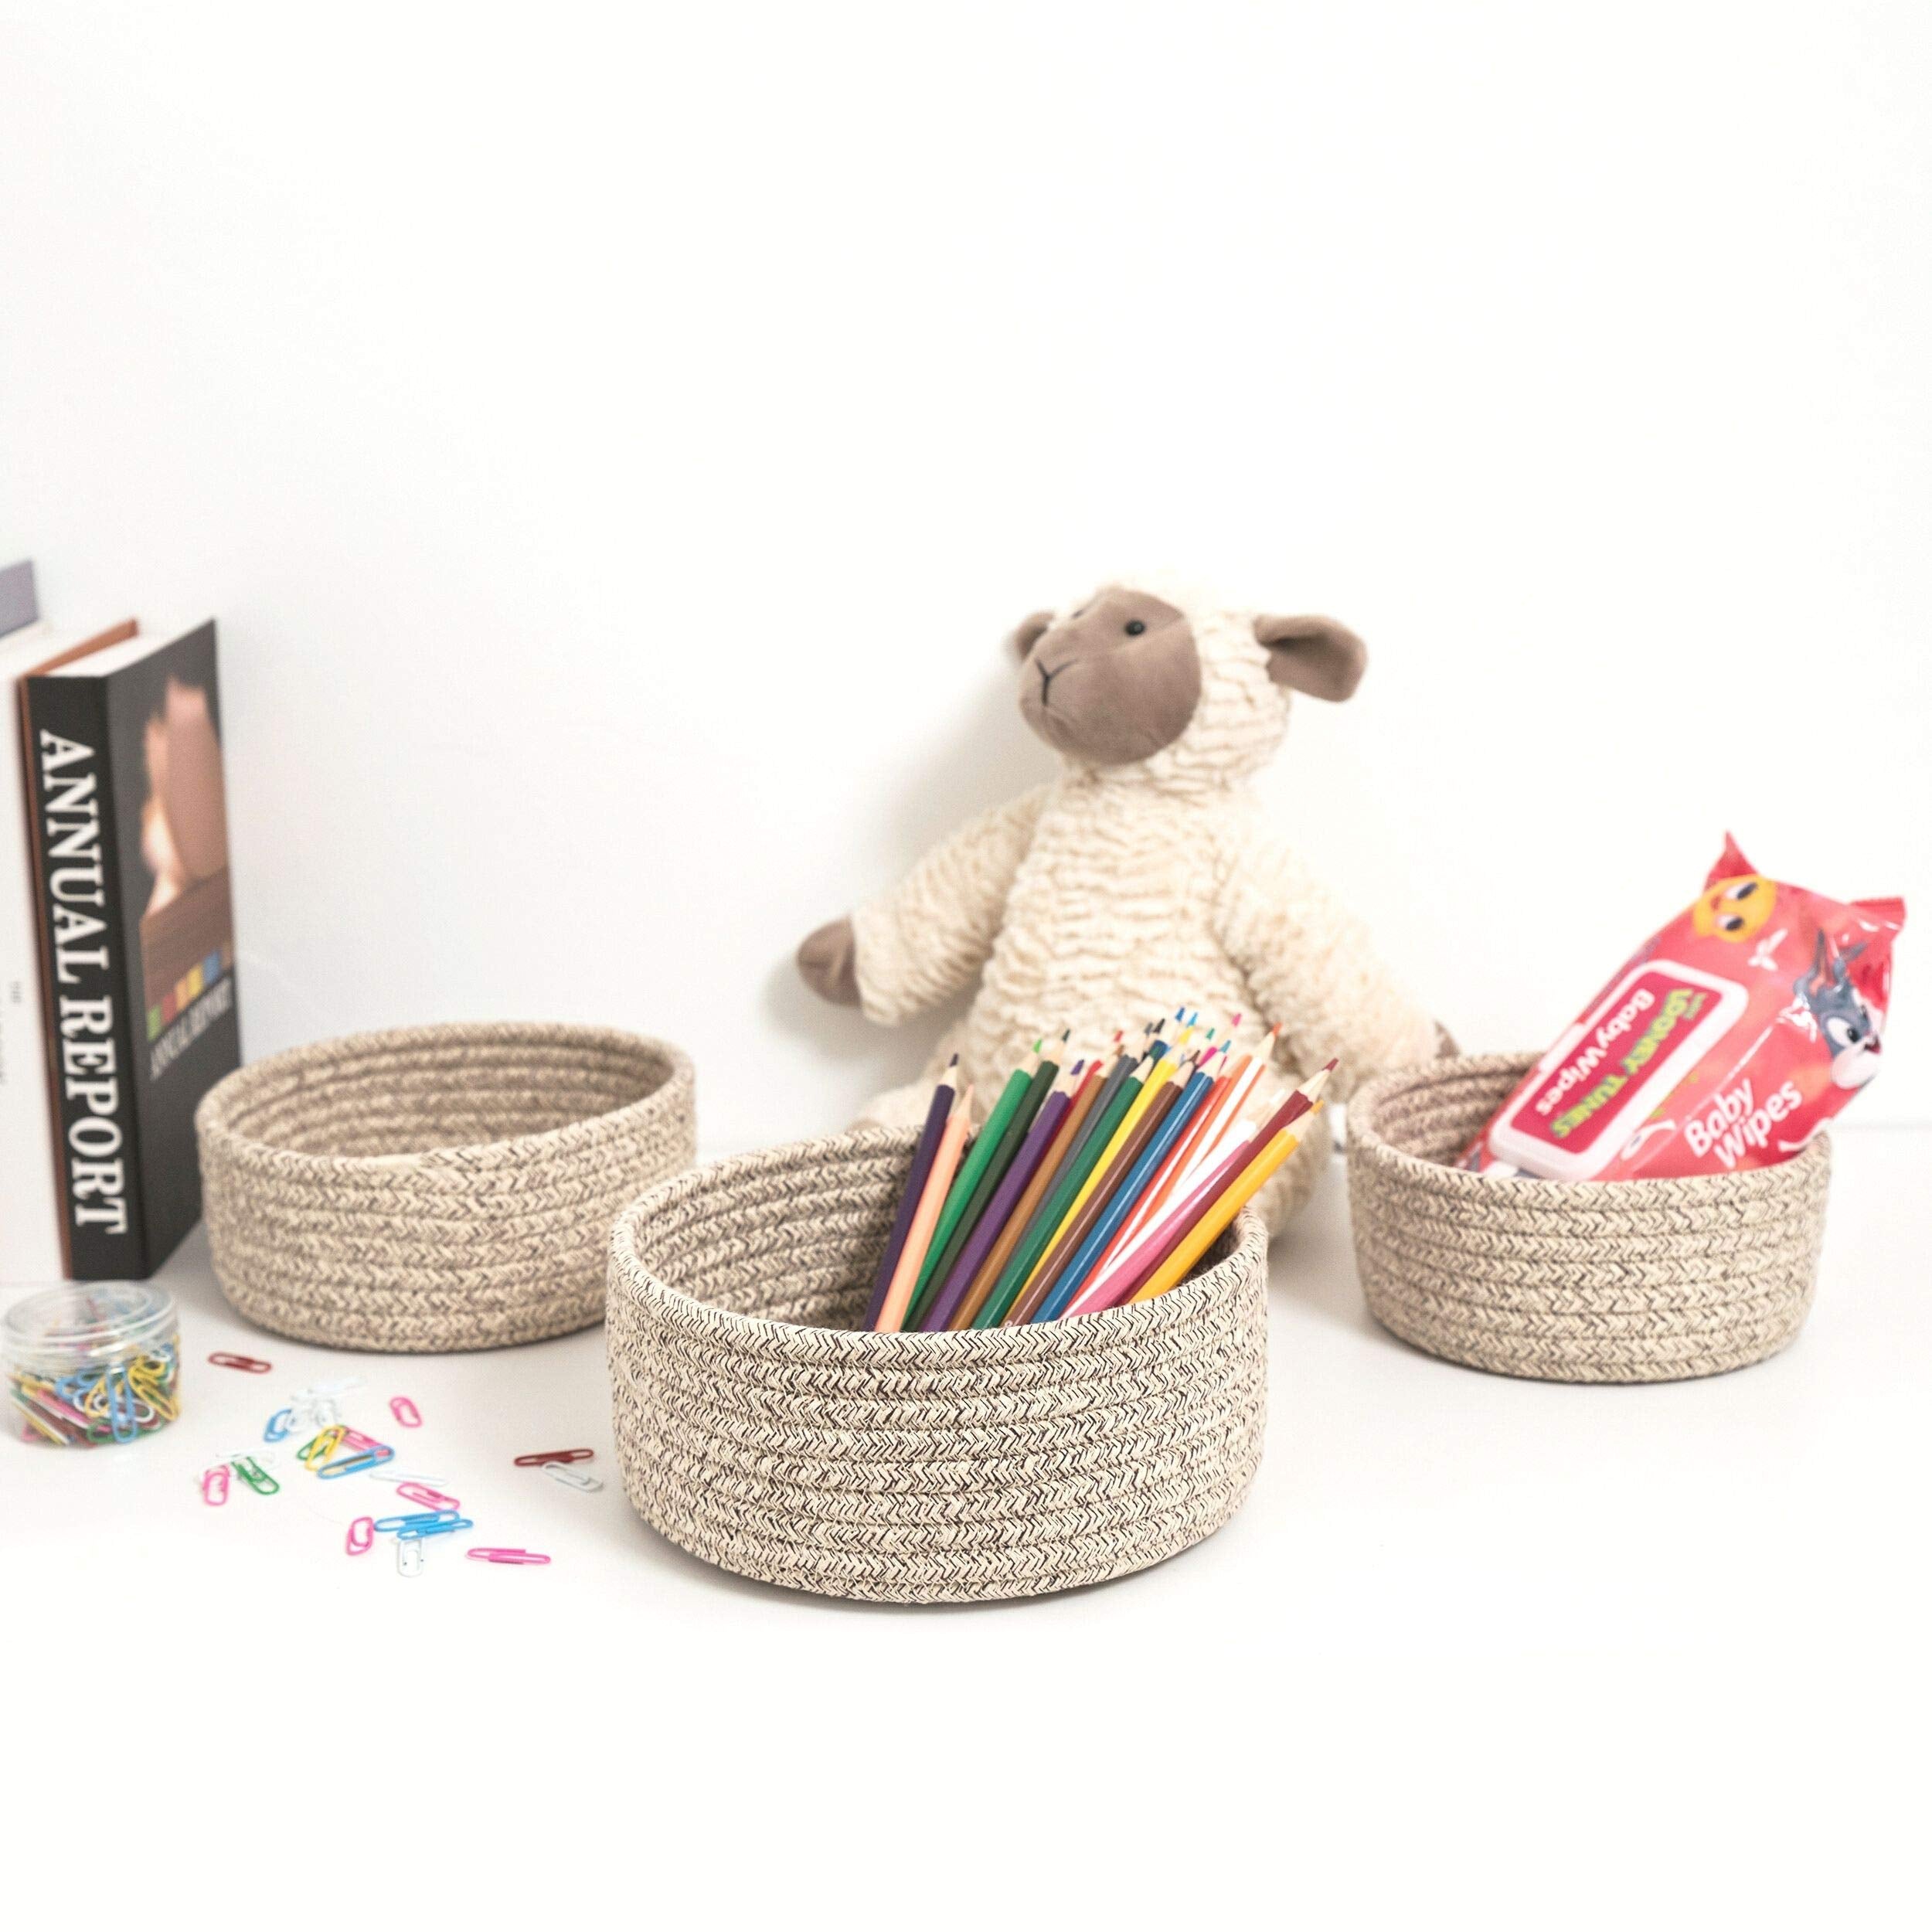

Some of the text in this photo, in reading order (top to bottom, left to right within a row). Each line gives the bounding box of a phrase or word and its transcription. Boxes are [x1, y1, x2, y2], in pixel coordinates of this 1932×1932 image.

[42, 730, 128, 1233] ANNUAL REPORT
[1685, 1078, 1754, 1158] Baby
[1714, 1080, 1802, 1168] Wipes
